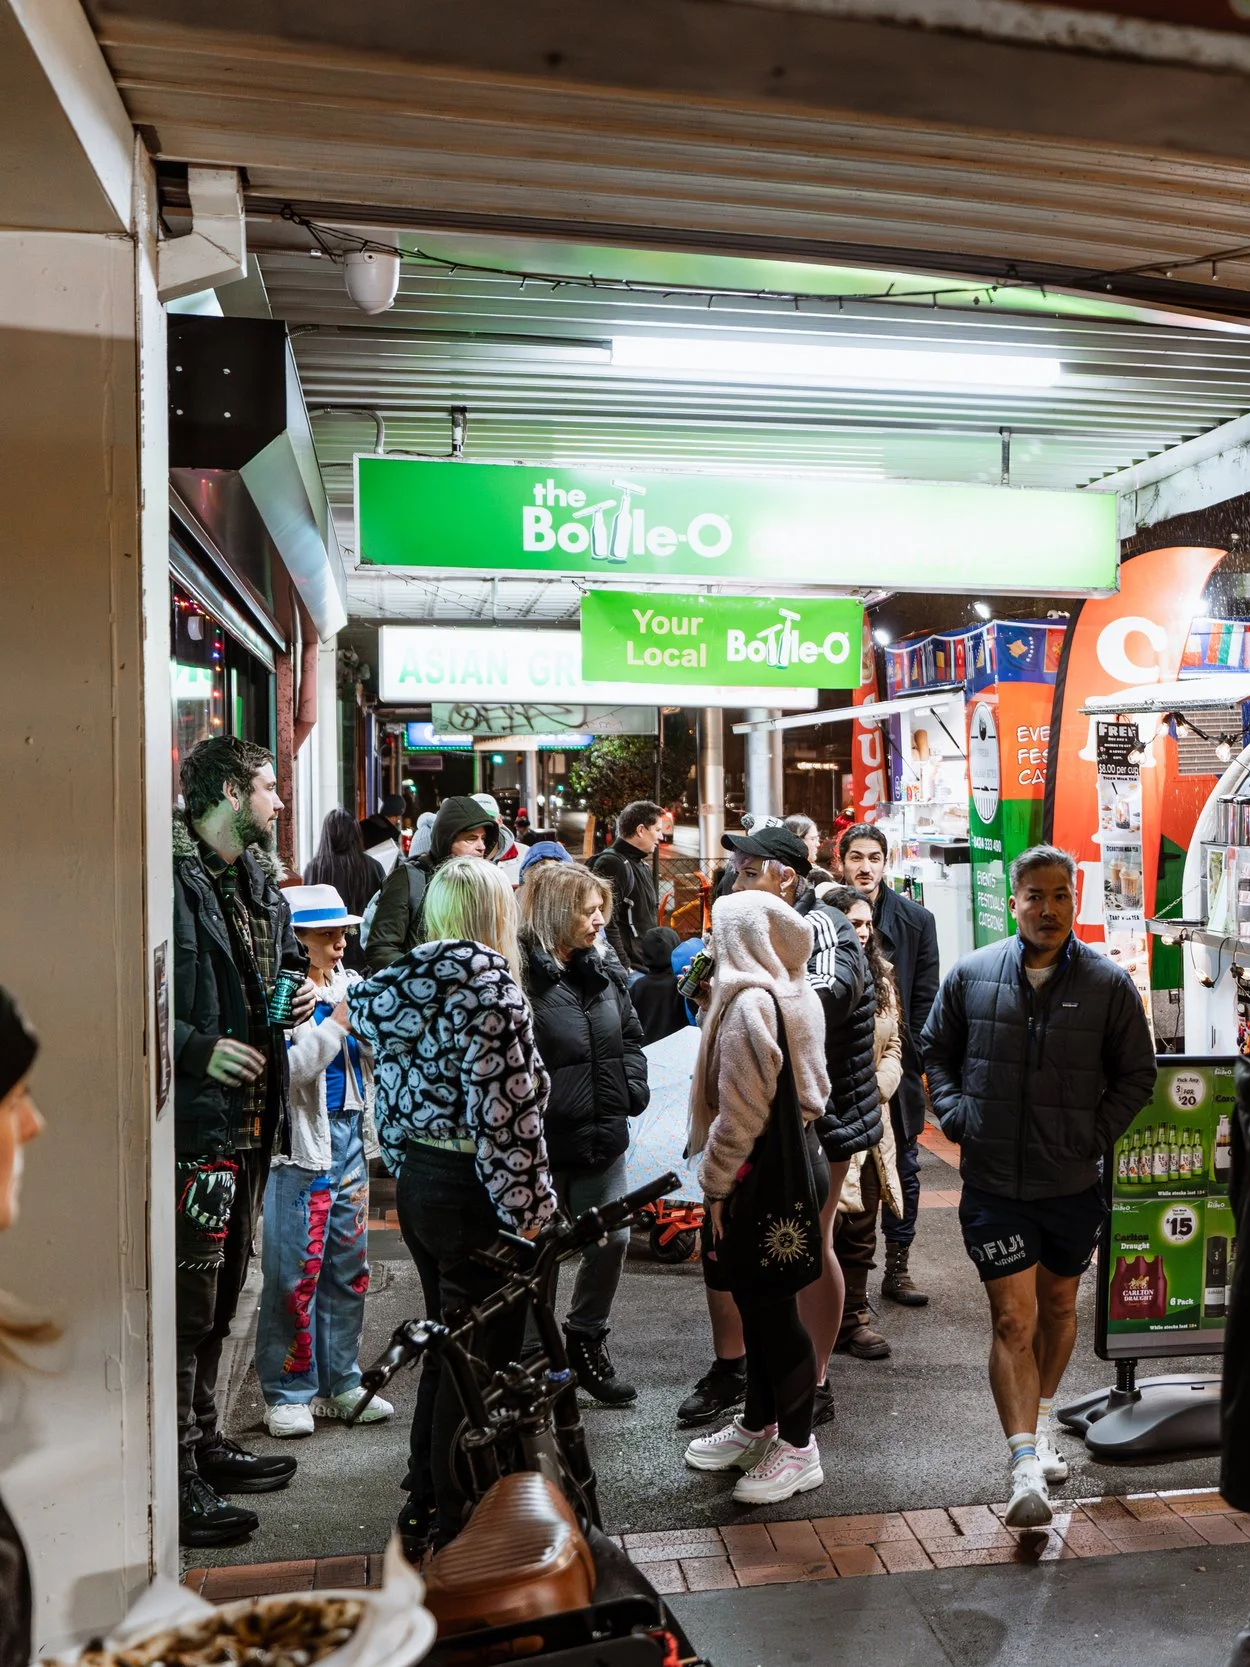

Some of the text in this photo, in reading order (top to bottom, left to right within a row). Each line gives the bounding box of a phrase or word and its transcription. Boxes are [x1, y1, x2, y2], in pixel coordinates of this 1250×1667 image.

[533, 479, 587, 507] the
[632, 609, 704, 635] Your
[627, 641, 706, 668] Local
[399, 648, 508, 685] ASIAN
[1018, 769, 1047, 784] CA
[1117, 766, 1126, 775] per
[1127, 766, 1139, 776] cup
[1175, 1085, 1181, 1093] 3
[1166, 1217, 1193, 1236] $15
[1115, 1233, 1149, 1241] Carlton
[983, 1234, 1024, 1260] FIJI
[1121, 1242, 1150, 1251] Draught
[1170, 1298, 1176, 1306] 6
